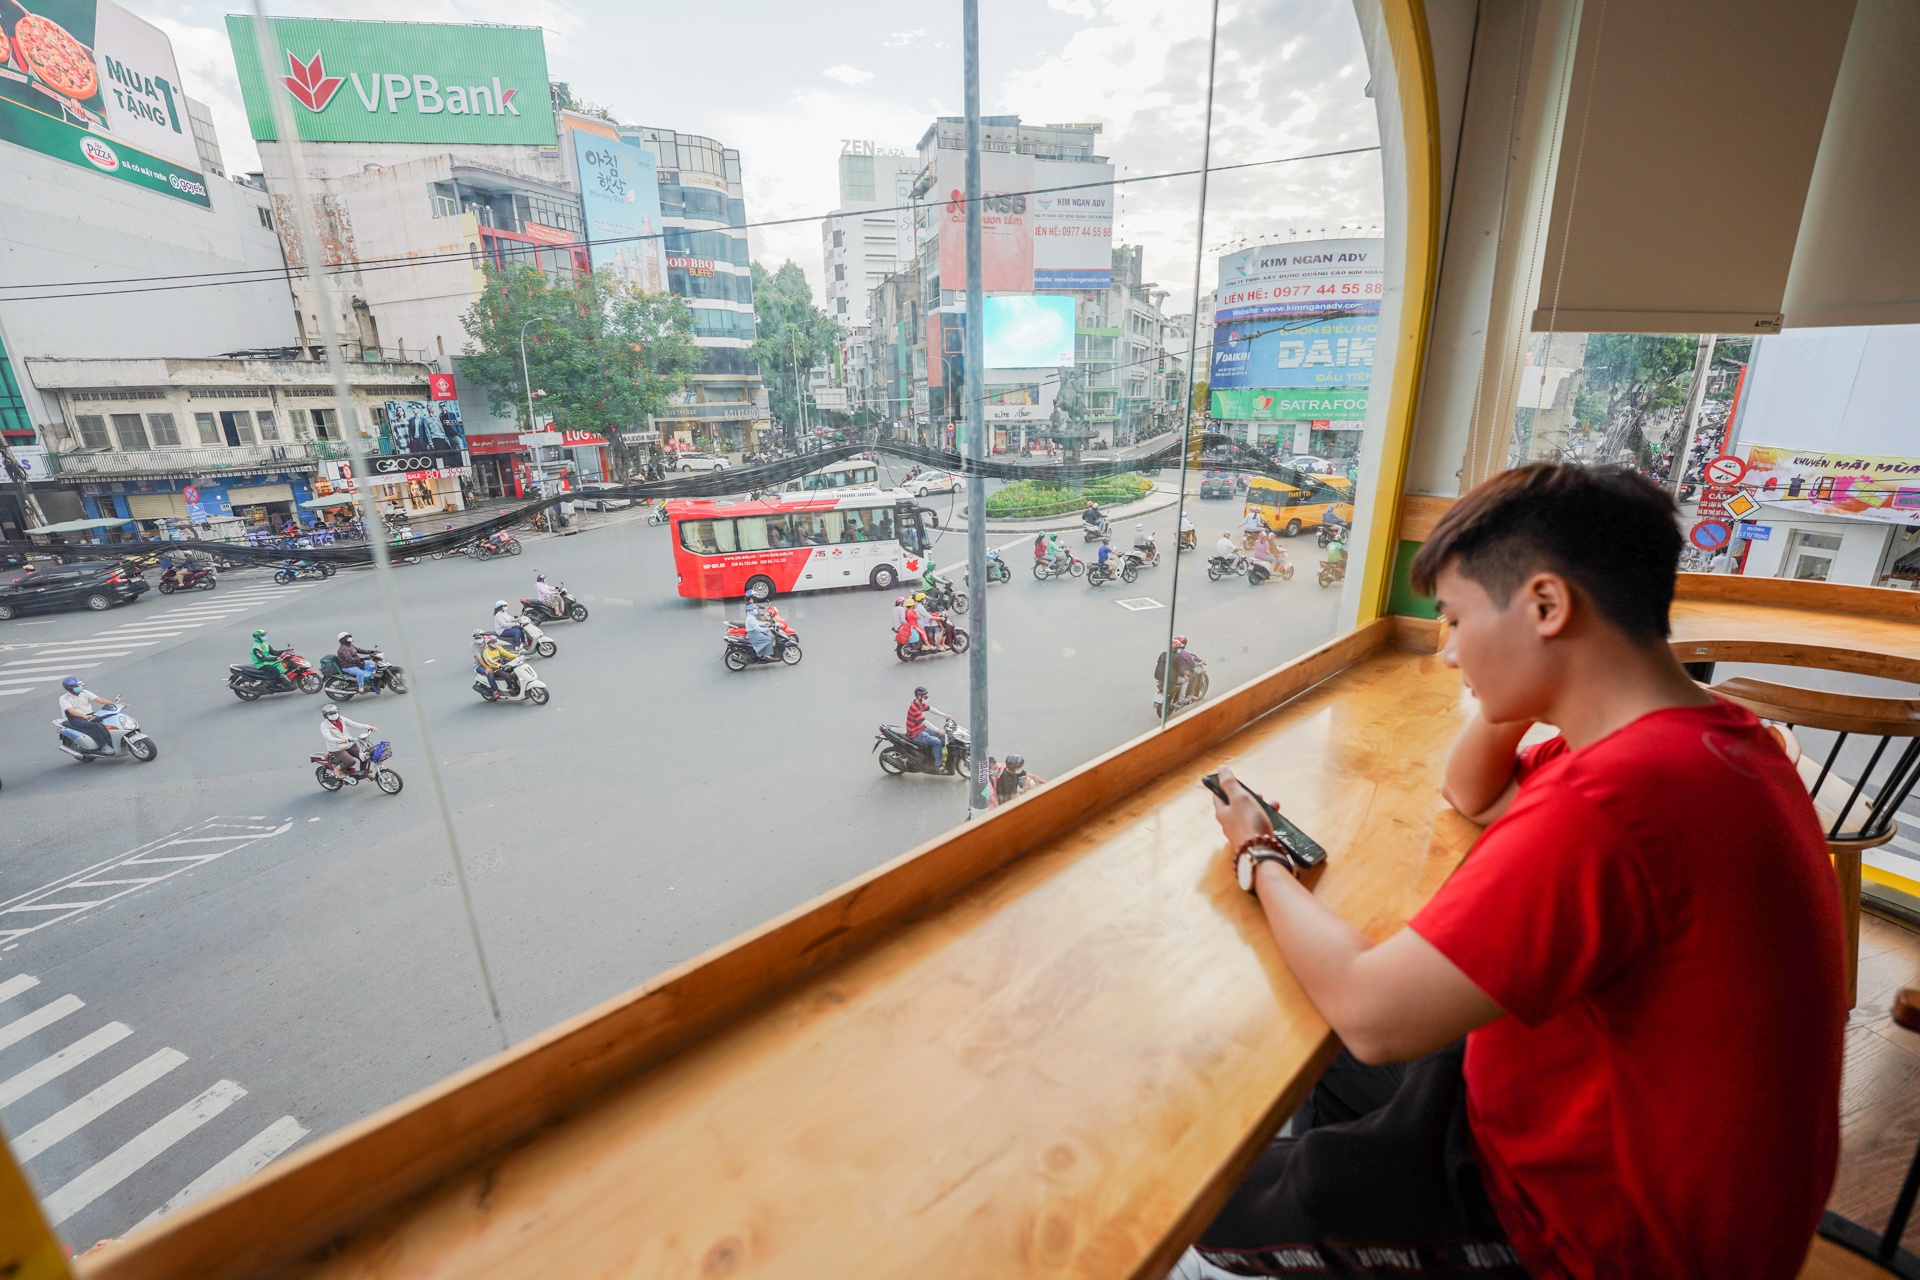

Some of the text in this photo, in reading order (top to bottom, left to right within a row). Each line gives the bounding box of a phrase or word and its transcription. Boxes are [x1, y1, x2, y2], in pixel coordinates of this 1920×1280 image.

[105, 55, 159, 101] MUA
[350, 72, 520, 116] VPBank
[113, 88, 166, 127] TẶNG
[87, 143, 113, 161] PIZZA
[841, 139, 906, 157] ZEN PLAZA
[585, 149, 618, 178] 아침
[179, 179, 206, 196] gojek
[983, 193, 1026, 214] MSB
[1058, 198, 1106, 207] KIM NGAN ADV
[1035, 225, 1112, 238] IÊN HỆ: 0977 44 55 88
[690, 258, 714, 270] BBQ
[1260, 253, 1367, 268] KIM NGAN ADV
[690, 268, 715, 278] BUFFET
[1224, 283, 1382, 304] LIÊN HỆ: 0977 44 55 88
[1232, 302, 1364, 316] Website: www.kimnganadv.com
[1356, 322, 1377, 332] HÒ
[1222, 352, 1250, 362] DAIKIN
[1278, 337, 1377, 368] DAIK
[1280, 399, 1368, 410] SATRAFOO
[376, 456, 432, 472] G2000
[1793, 455, 1831, 468] KHUYẾN
[1834, 460, 1870, 470] MÃI
